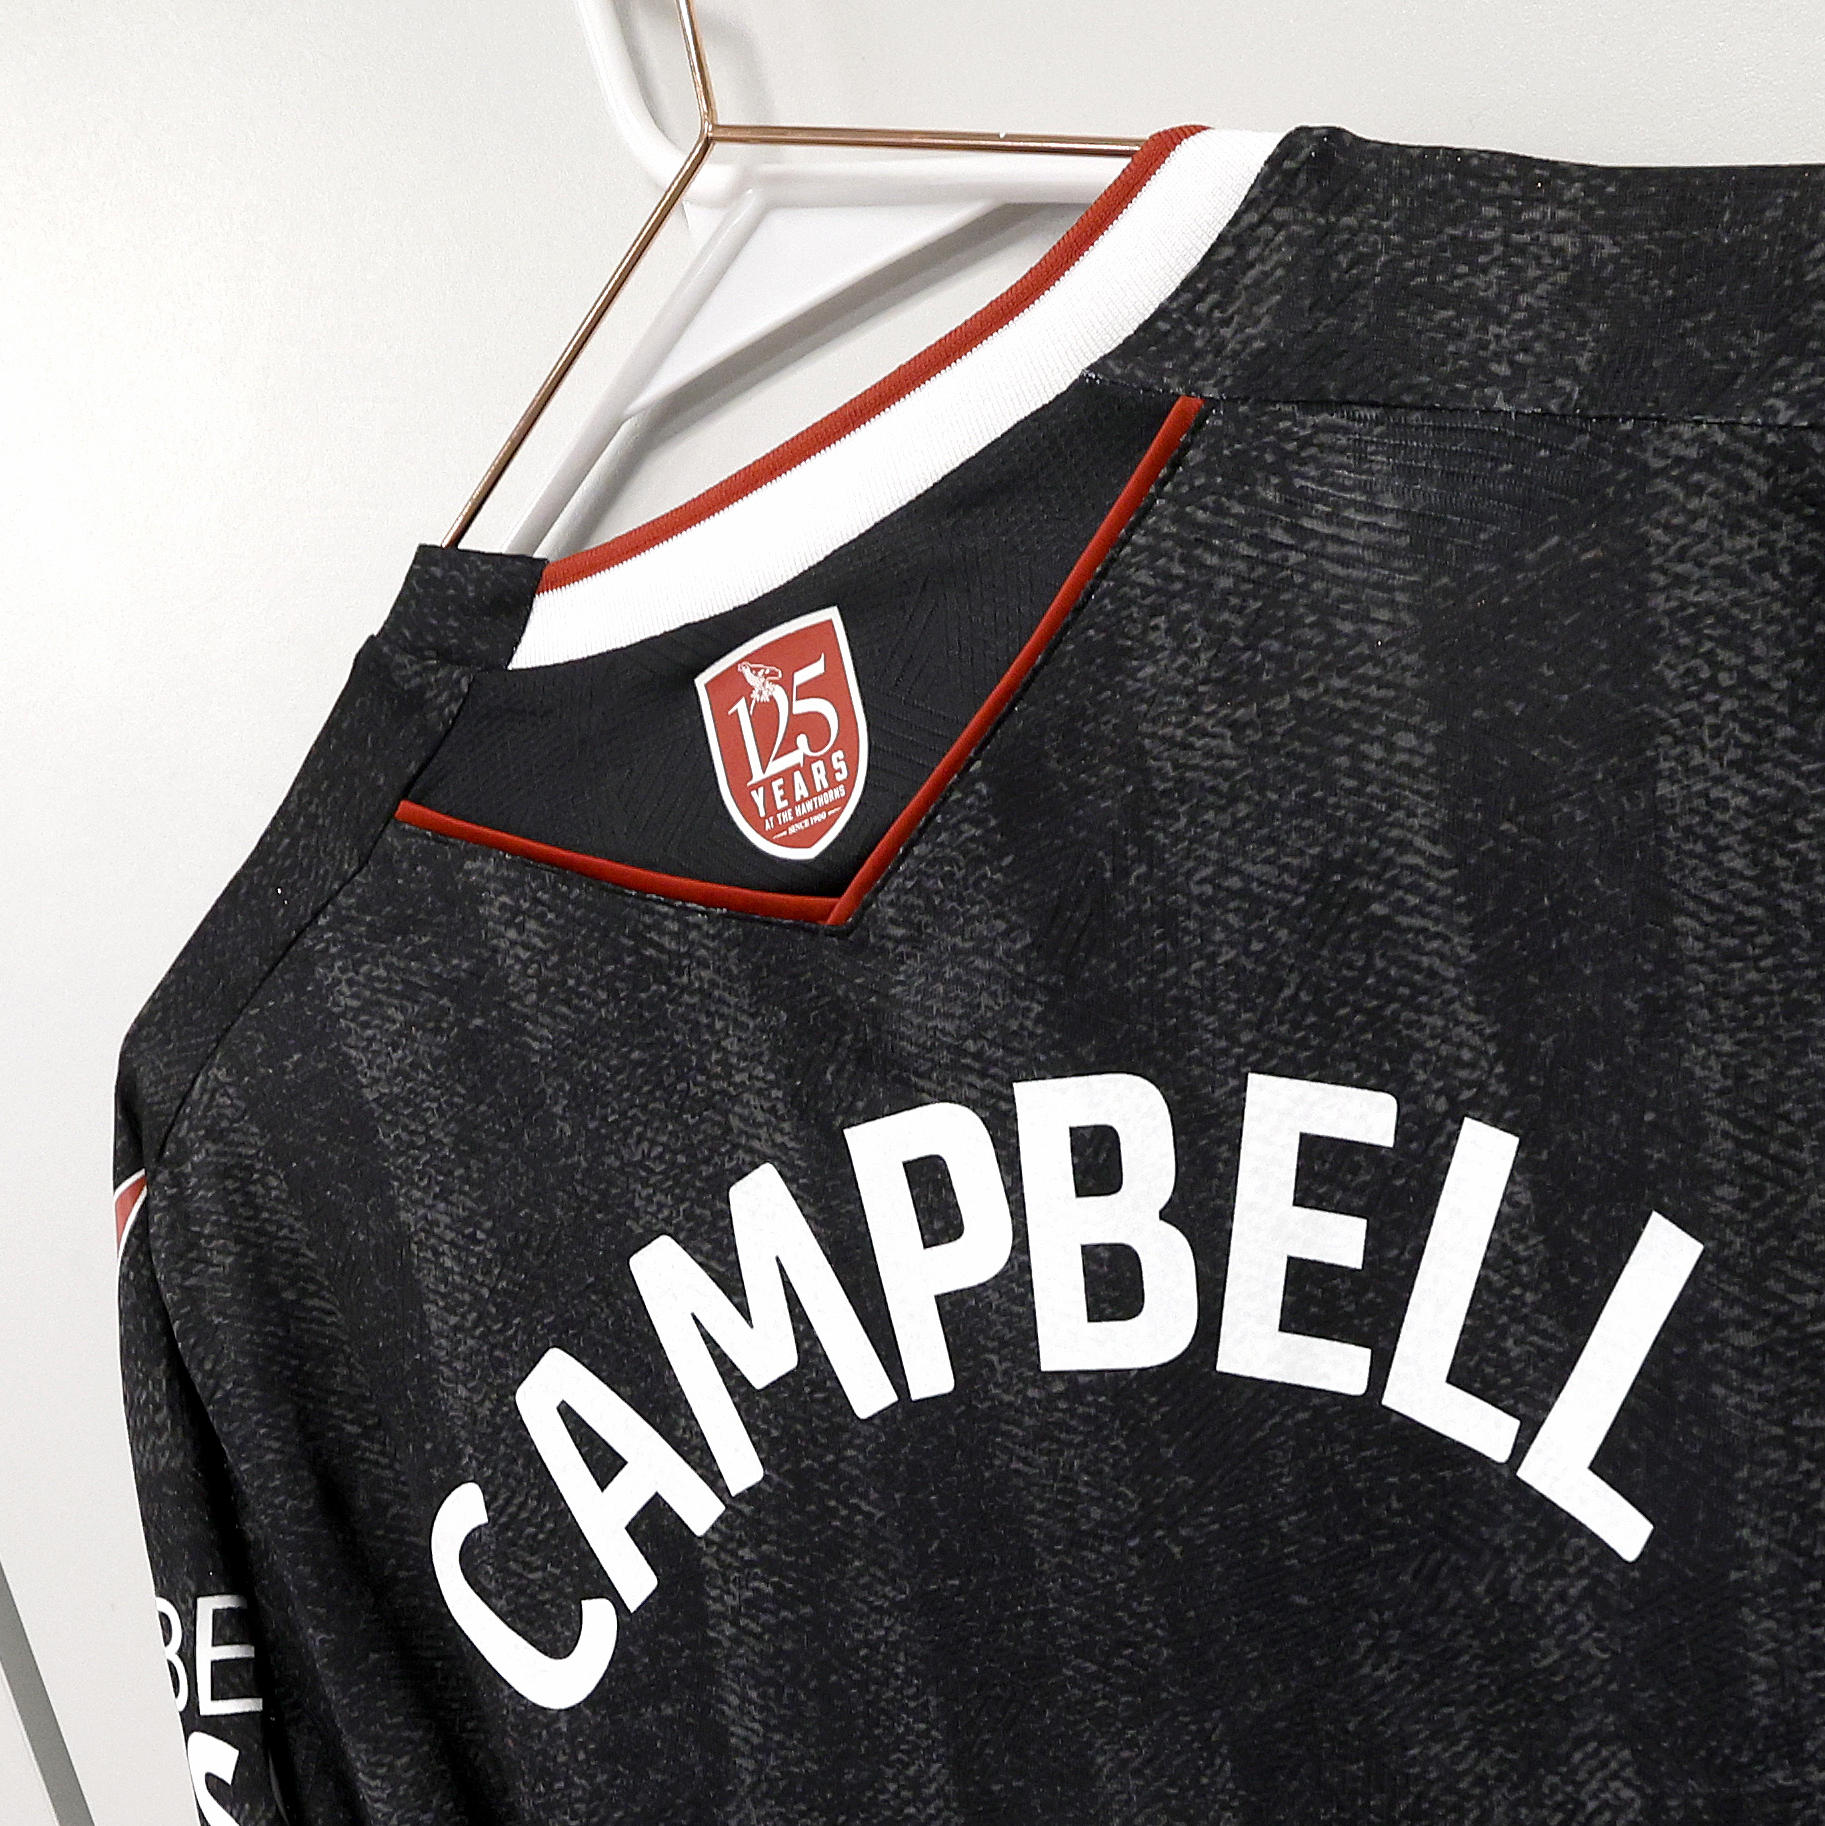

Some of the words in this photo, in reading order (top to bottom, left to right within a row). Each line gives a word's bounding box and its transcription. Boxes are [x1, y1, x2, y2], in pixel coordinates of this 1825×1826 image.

[728, 652, 839, 787] 125
[751, 750, 849, 818] YEARS
[764, 816, 774, 831] AT
[776, 808, 793, 825] THE
[795, 784, 846, 817] HAWTHORNS
[431, 1072, 1704, 1709] CAMPBELL
